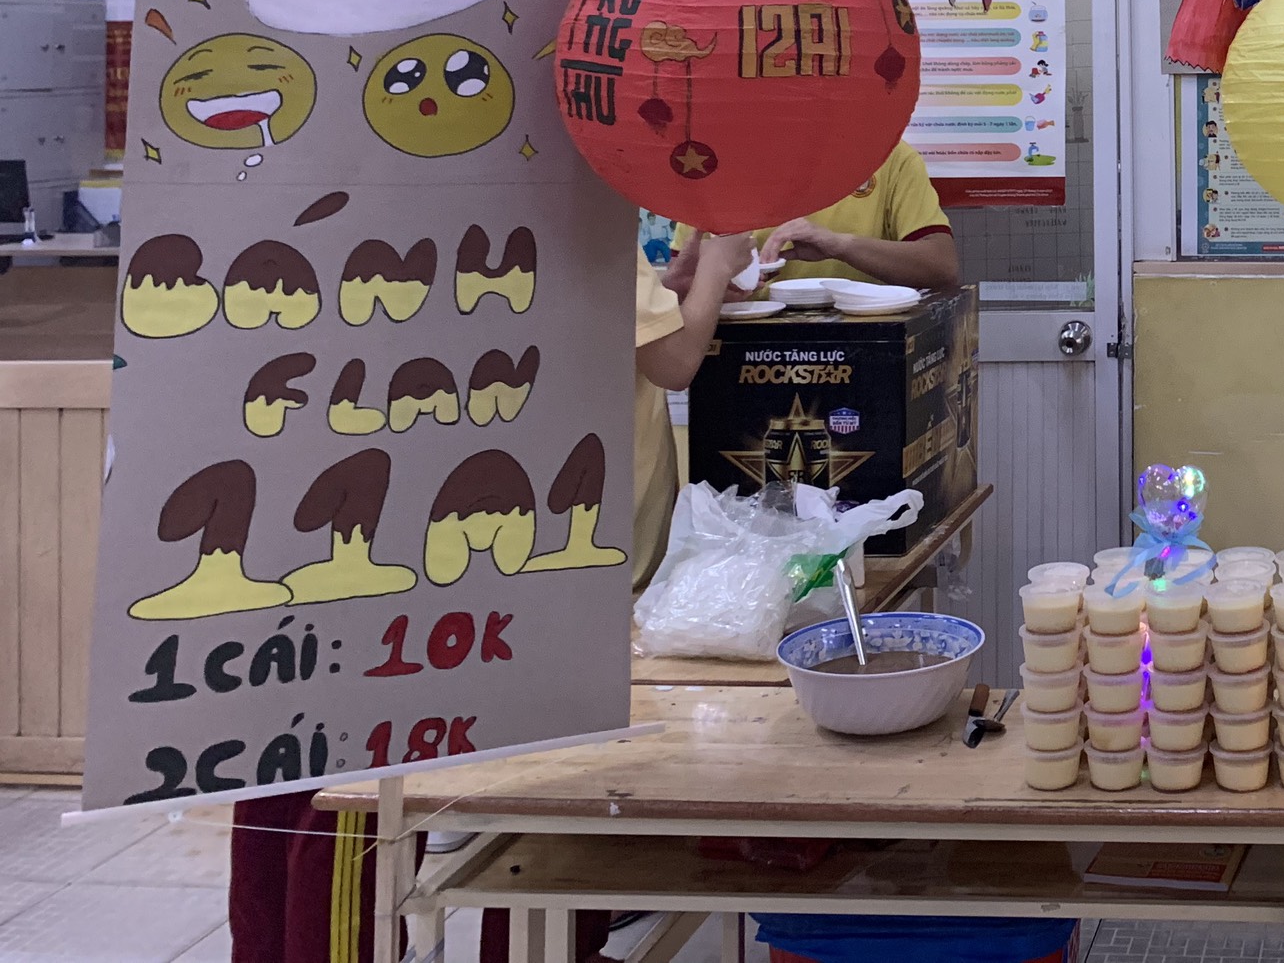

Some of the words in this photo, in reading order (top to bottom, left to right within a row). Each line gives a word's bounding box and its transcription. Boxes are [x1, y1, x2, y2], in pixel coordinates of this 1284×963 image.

[121, 191, 537, 338] BÁNH
[738, 364, 853, 384] ROCKSTAR
[745, 349, 782, 362] NƯỚC
[784, 348, 818, 362] TĂNG
[820, 350, 846, 365] LỰC
[243, 345, 541, 438] FLAN
[127, 432, 628, 621] 11A1
[363, 611, 513, 677] 10K
[366, 716, 478, 769] 18K
